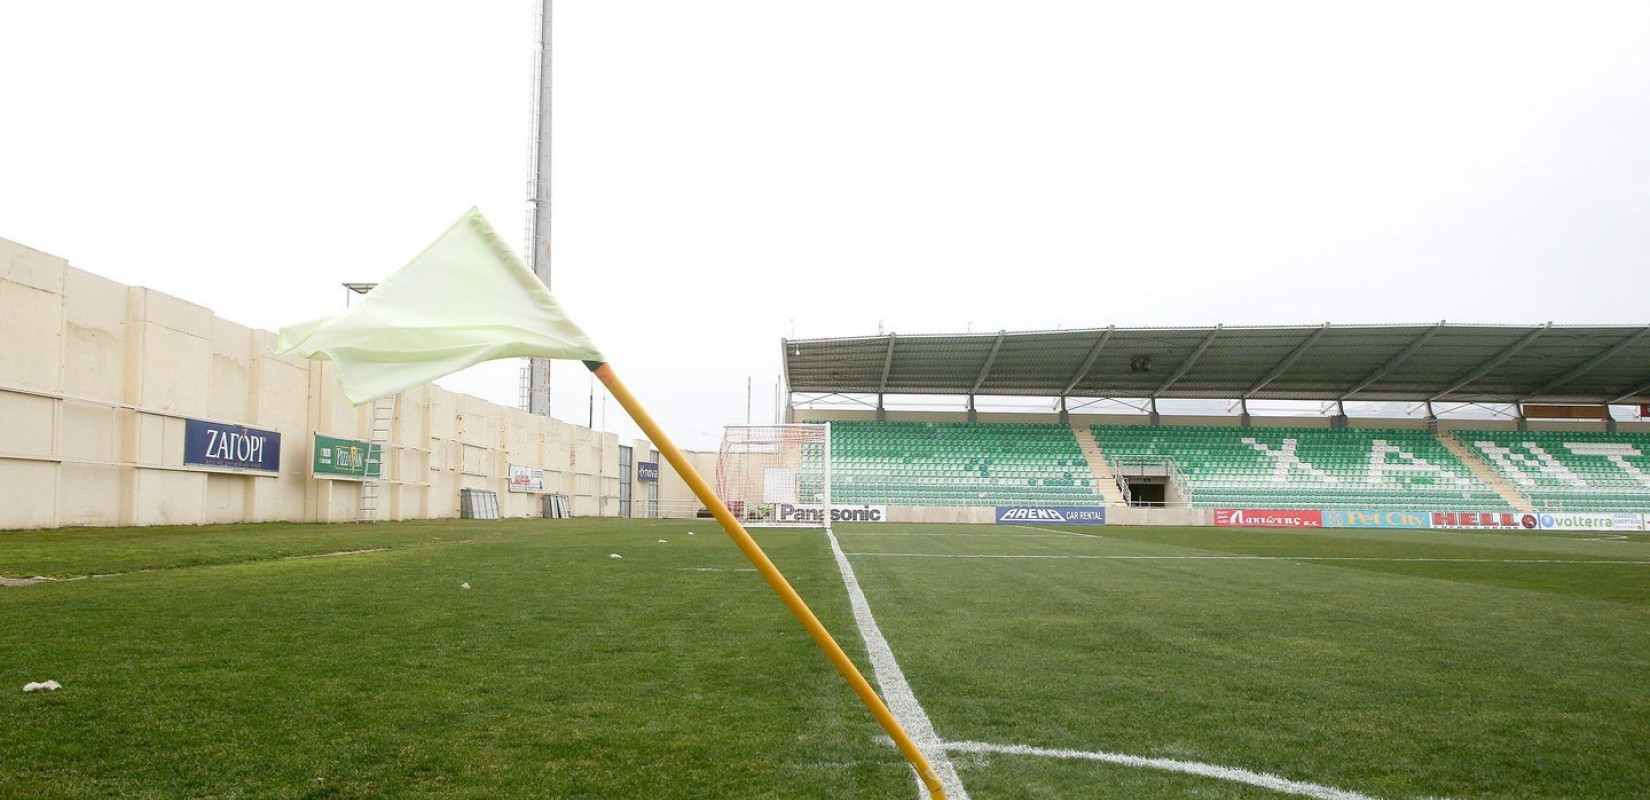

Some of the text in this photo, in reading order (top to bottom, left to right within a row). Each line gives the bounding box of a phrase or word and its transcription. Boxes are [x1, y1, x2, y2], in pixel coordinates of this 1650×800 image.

[1000, 508, 1103, 521] ARENA CAR RENTAL
[1347, 511, 1425, 527] Pet City
[1432, 511, 1520, 526] HELL
[1555, 515, 1613, 527] volterra
